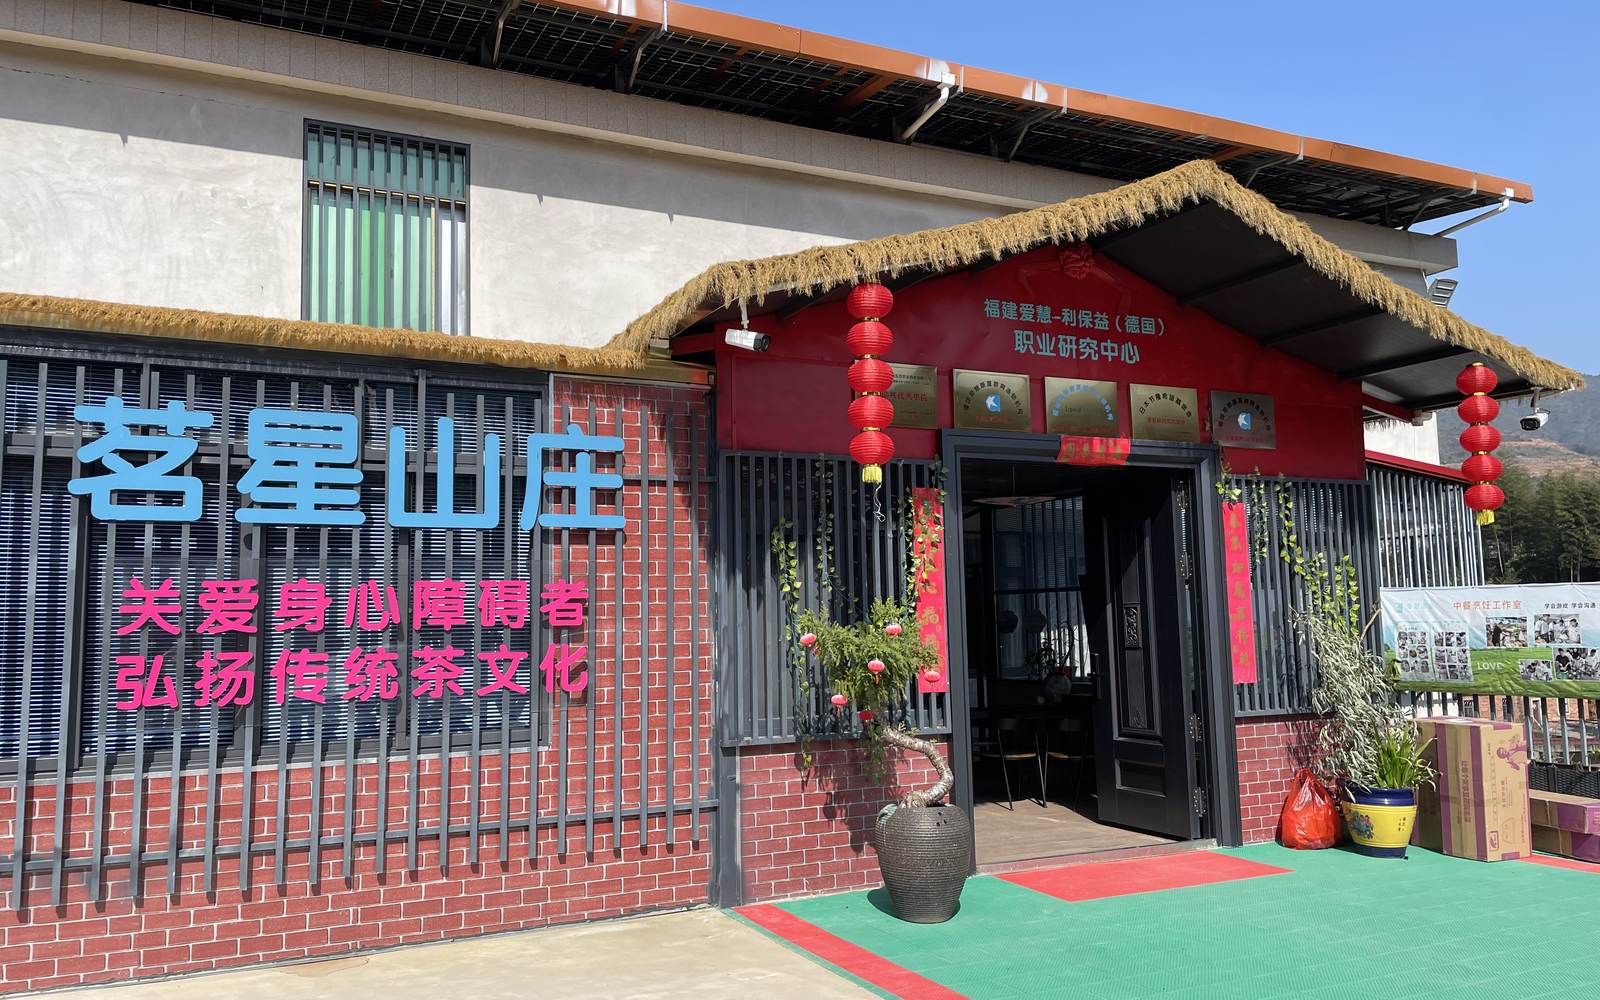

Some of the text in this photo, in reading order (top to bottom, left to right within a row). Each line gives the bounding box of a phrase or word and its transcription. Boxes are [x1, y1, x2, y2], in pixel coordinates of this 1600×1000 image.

[1014, 329, 1140, 364] 职业研究中心
[67, 396, 626, 531] 茗星山庄
[117, 577, 589, 635] 关爱身心障碍者
[1452, 600, 1521, 610] 中餐烹饪工作室
[115, 643, 589, 710] 弘扬传统茶文化
